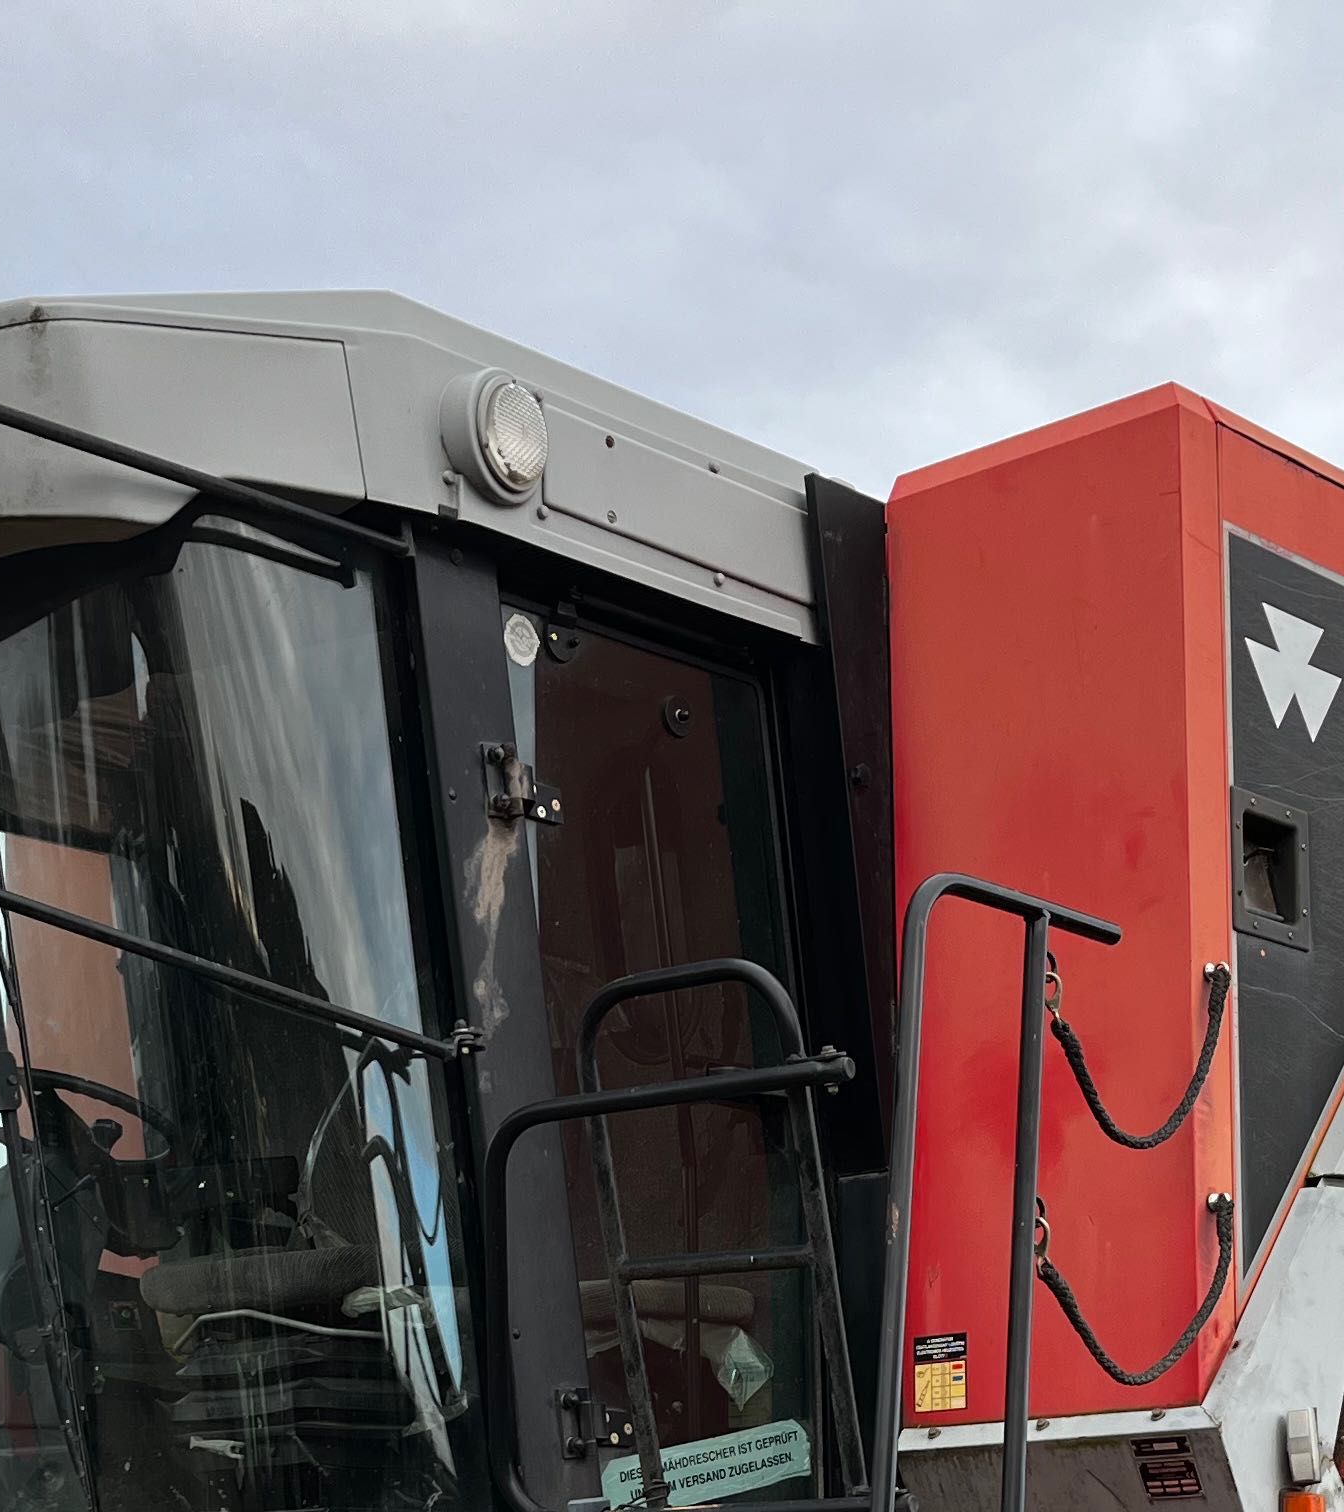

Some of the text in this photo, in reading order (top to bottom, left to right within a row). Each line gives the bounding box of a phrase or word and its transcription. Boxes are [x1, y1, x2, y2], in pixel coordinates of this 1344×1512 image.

[738, 1441, 753, 1455] IST
[755, 1431, 799, 1451] GEPRÜFT
[678, 1468, 727, 1488] VERSAND
